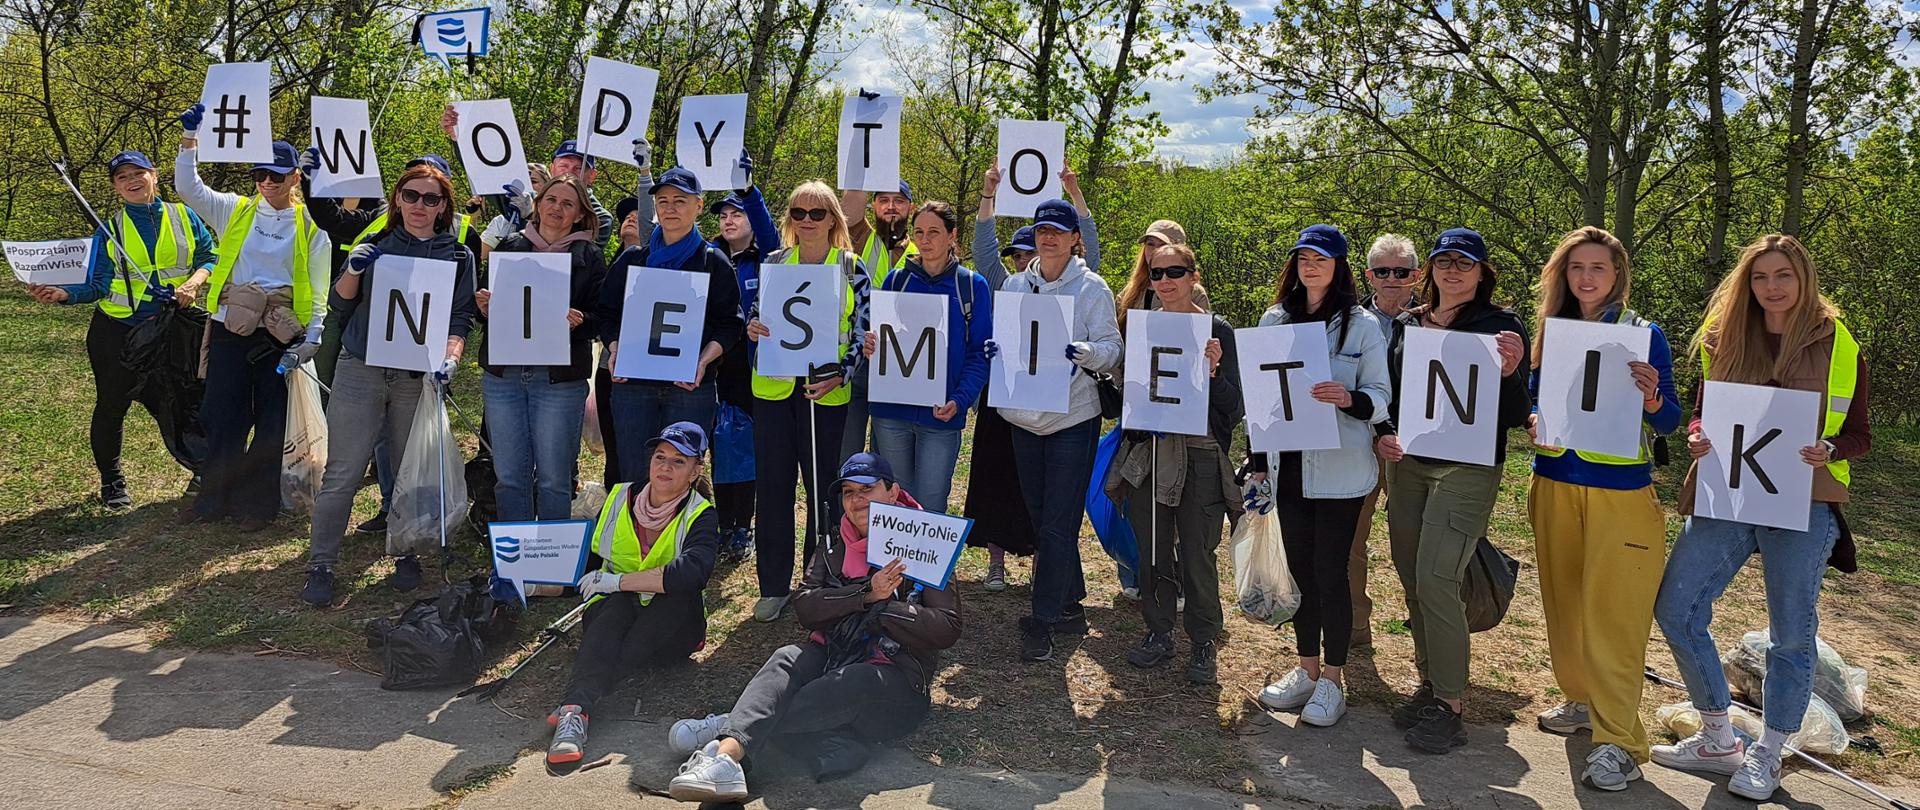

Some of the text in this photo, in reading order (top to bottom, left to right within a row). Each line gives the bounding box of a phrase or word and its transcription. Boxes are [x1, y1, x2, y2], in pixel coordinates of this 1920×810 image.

[212, 94, 251, 149] #
[593, 87, 632, 137] D
[314, 126, 367, 175] W
[471, 122, 512, 167] O
[693, 120, 726, 168] Y
[852, 122, 883, 169] T
[1009, 148, 1049, 196] O
[6, 244, 86, 257] #Posprzątajmy
[14, 259, 82, 271] RazemWisłę
[385, 288, 431, 346] N
[523, 285, 532, 340] I
[647, 301, 687, 358] E
[779, 281, 814, 351] Ś
[878, 323, 936, 381] M
[1028, 320, 1039, 376] I
[1148, 346, 1183, 405] E
[1259, 360, 1305, 422] T
[1425, 359, 1479, 426] N
[1580, 349, 1602, 413] I
[1728, 423, 1783, 495] K
[524, 550, 559, 559] Wody Polskie
[872, 514, 958, 542] #WodyToNie
[884, 538, 938, 565] Śmietnik
